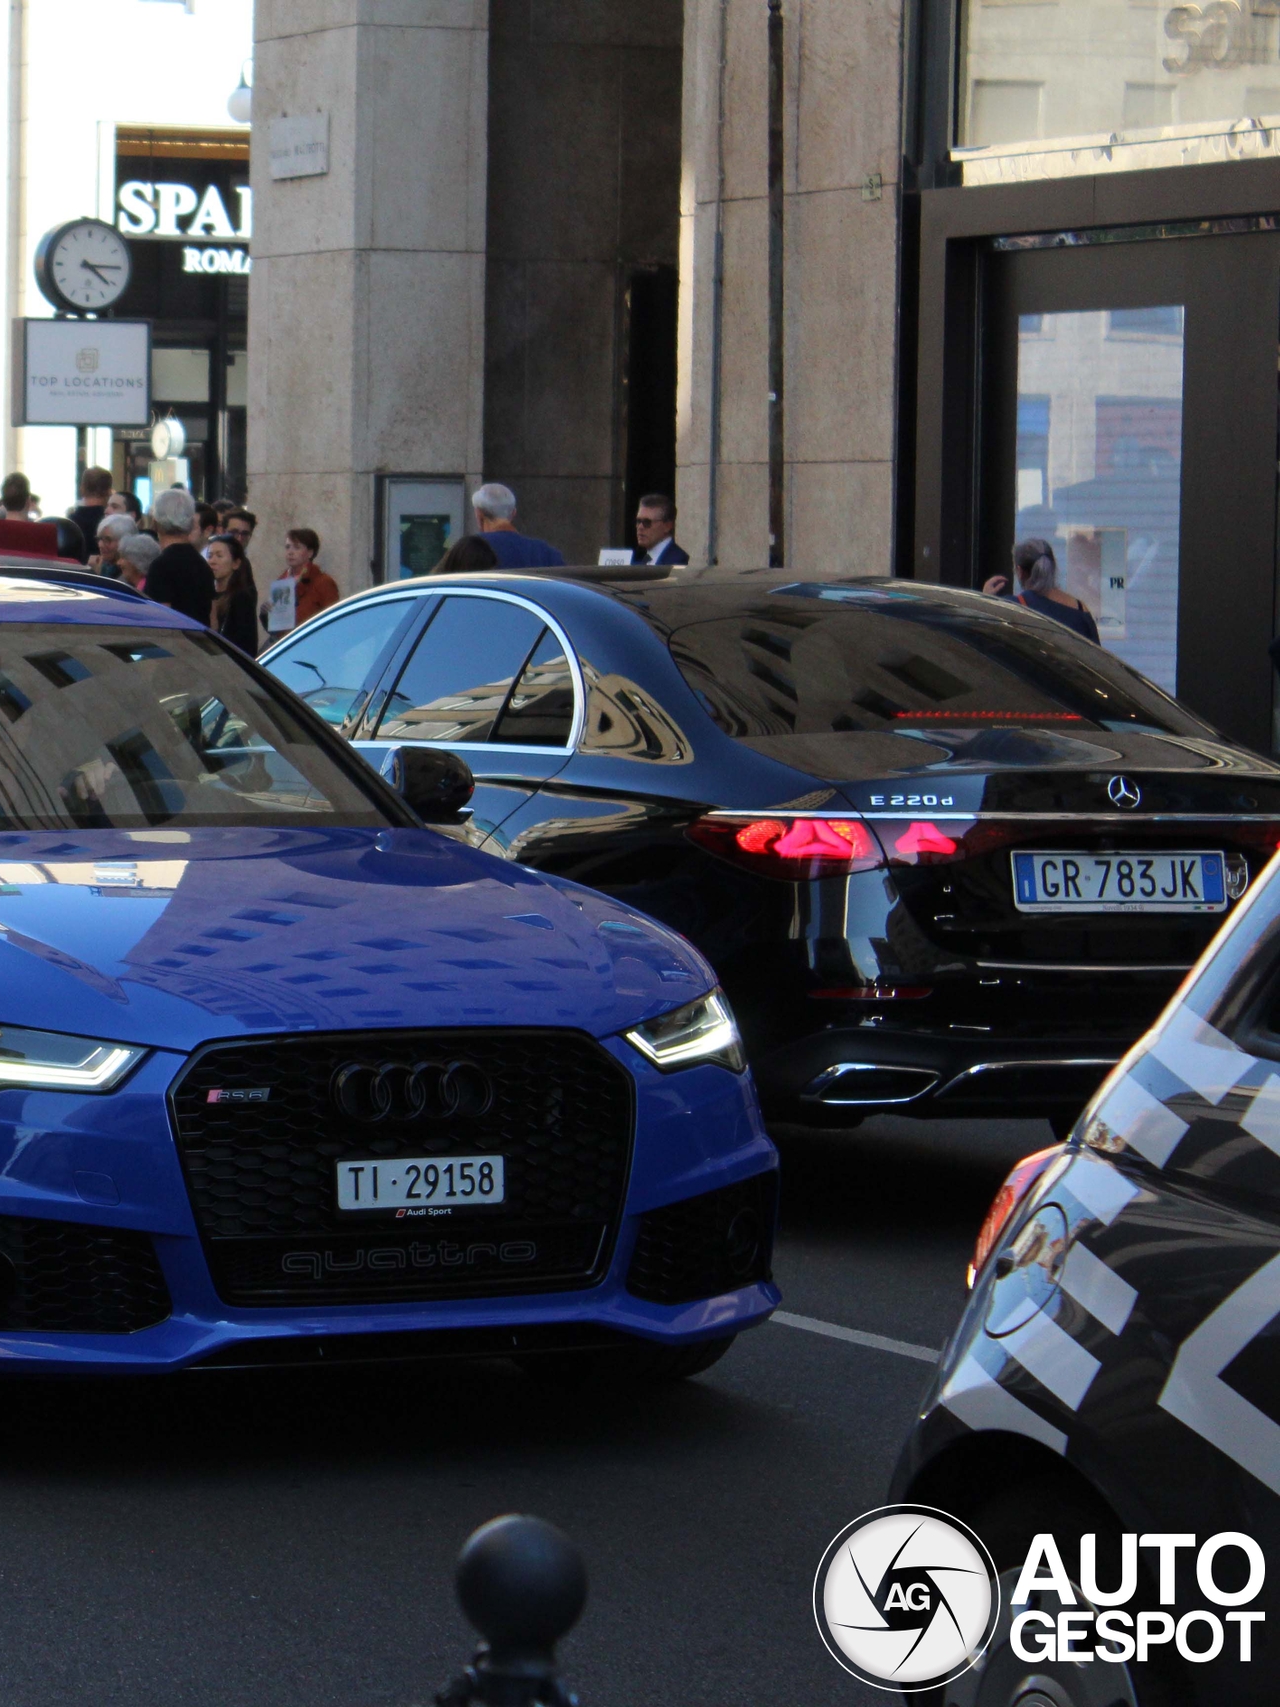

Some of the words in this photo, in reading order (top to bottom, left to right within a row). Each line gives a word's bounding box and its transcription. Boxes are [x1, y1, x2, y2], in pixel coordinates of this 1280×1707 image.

[31, 376, 58, 387] TOP
[64, 377, 144, 389] LOCATIONS
[870, 795, 885, 806] E
[1041, 860, 1081, 897] GR
[1094, 860, 1199, 898] 783JK
[404, 1161, 494, 1199] 29158
[428, 1208, 452, 1218] Sport
[282, 1240, 536, 1279] quattro
